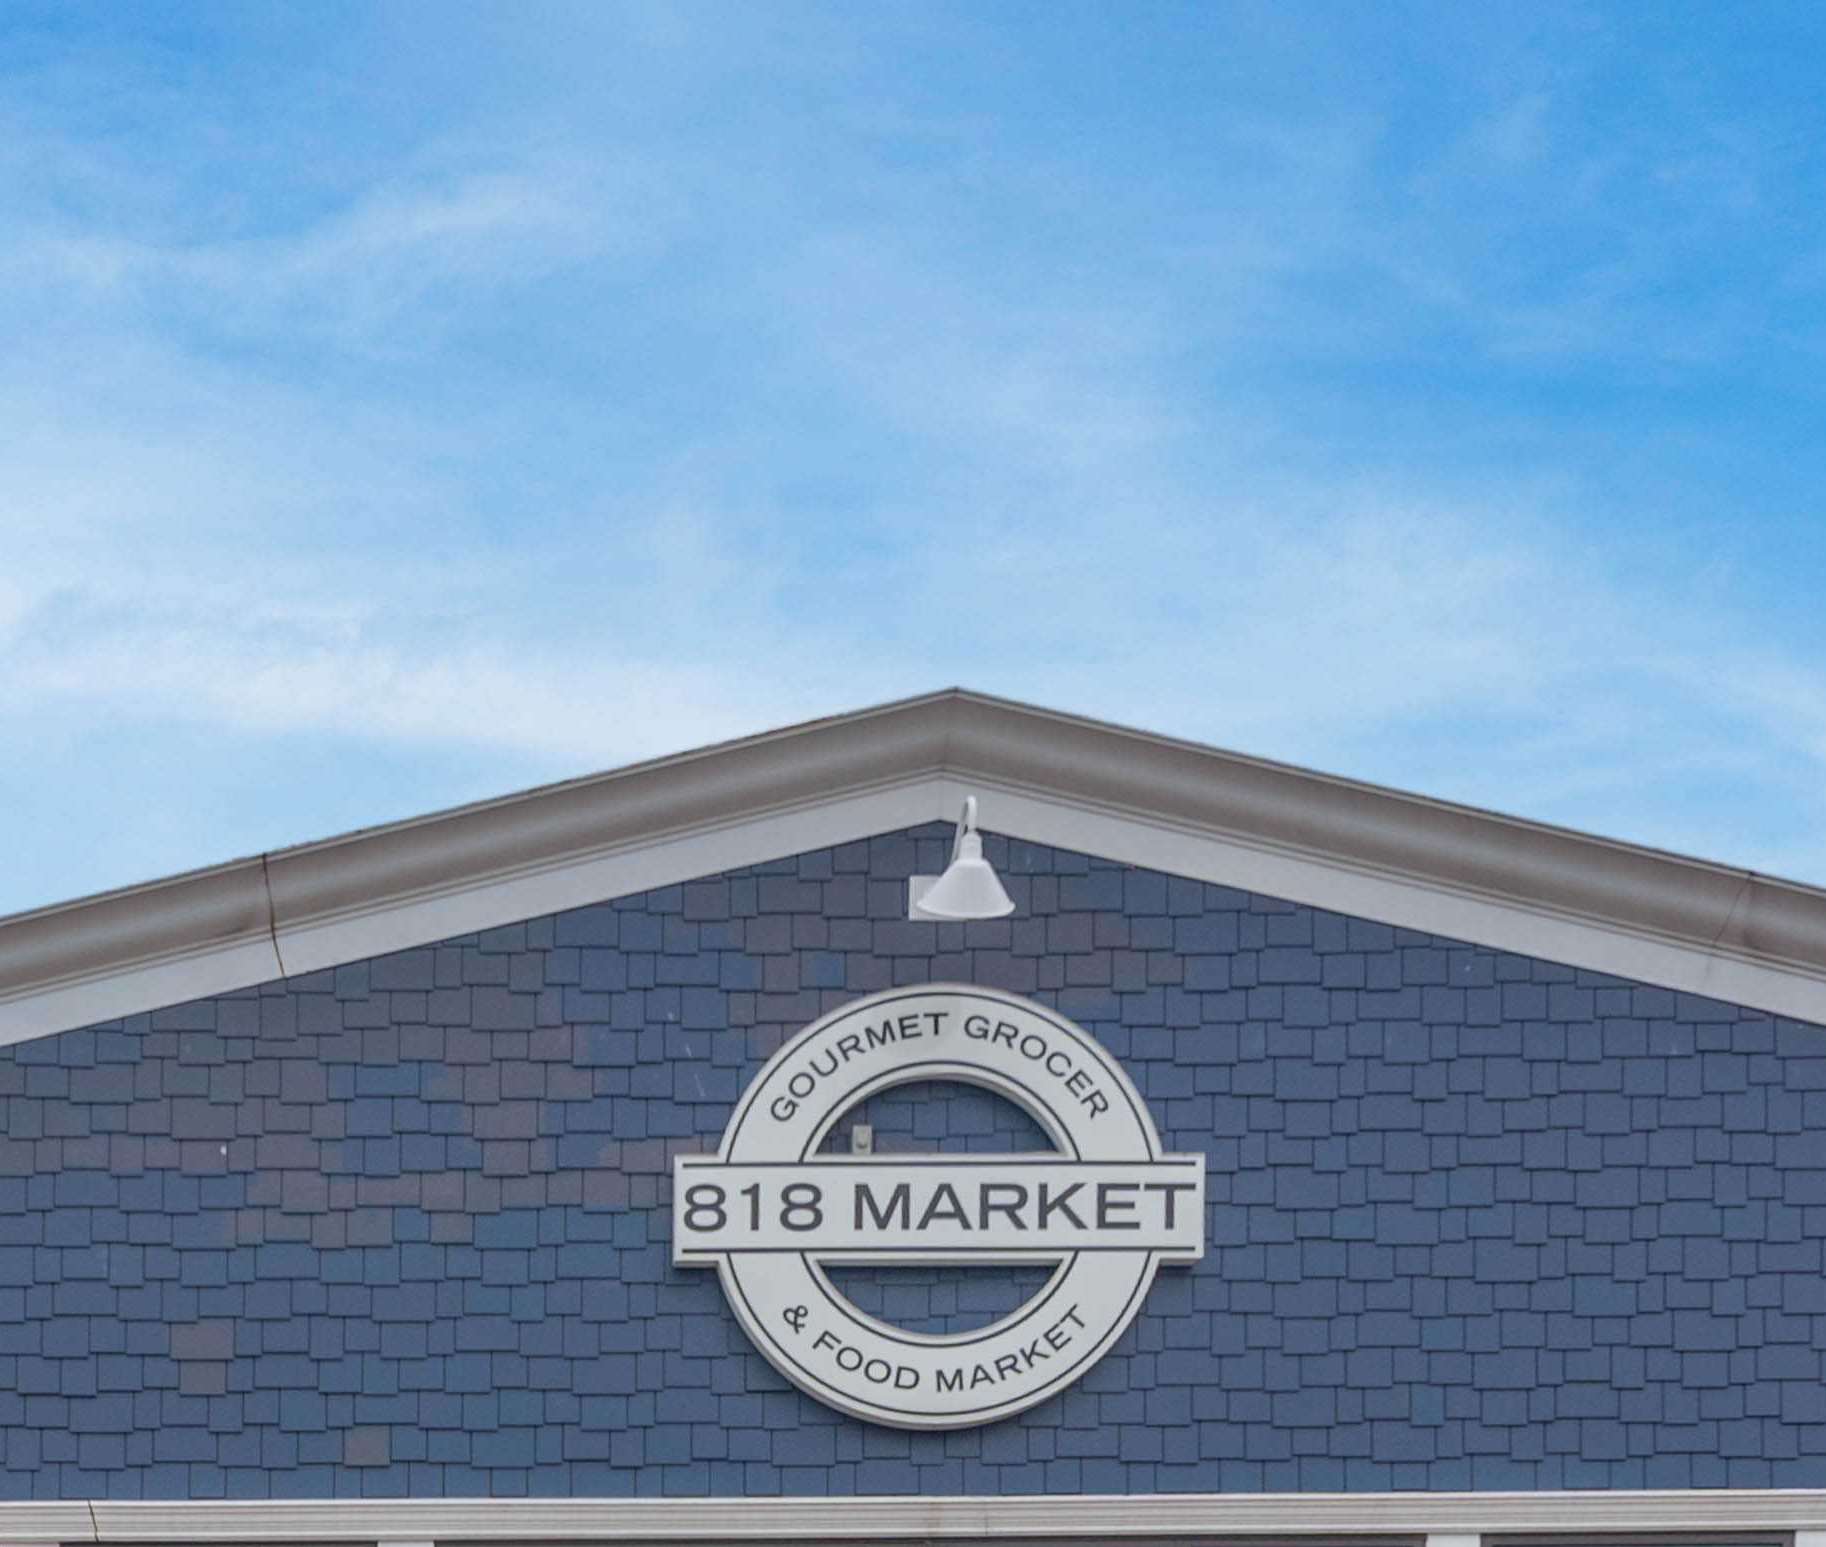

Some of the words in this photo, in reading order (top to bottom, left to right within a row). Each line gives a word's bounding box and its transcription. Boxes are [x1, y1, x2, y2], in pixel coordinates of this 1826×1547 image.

[770, 1012, 950, 1123] GOURMET
[963, 1015, 1110, 1120] GROCER
[683, 1182, 825, 1232] 818
[854, 1182, 1197, 1231] MARKET
[782, 1303, 810, 1334] &
[812, 1332, 921, 1391] FOOD
[935, 1303, 1088, 1394] MARKET
